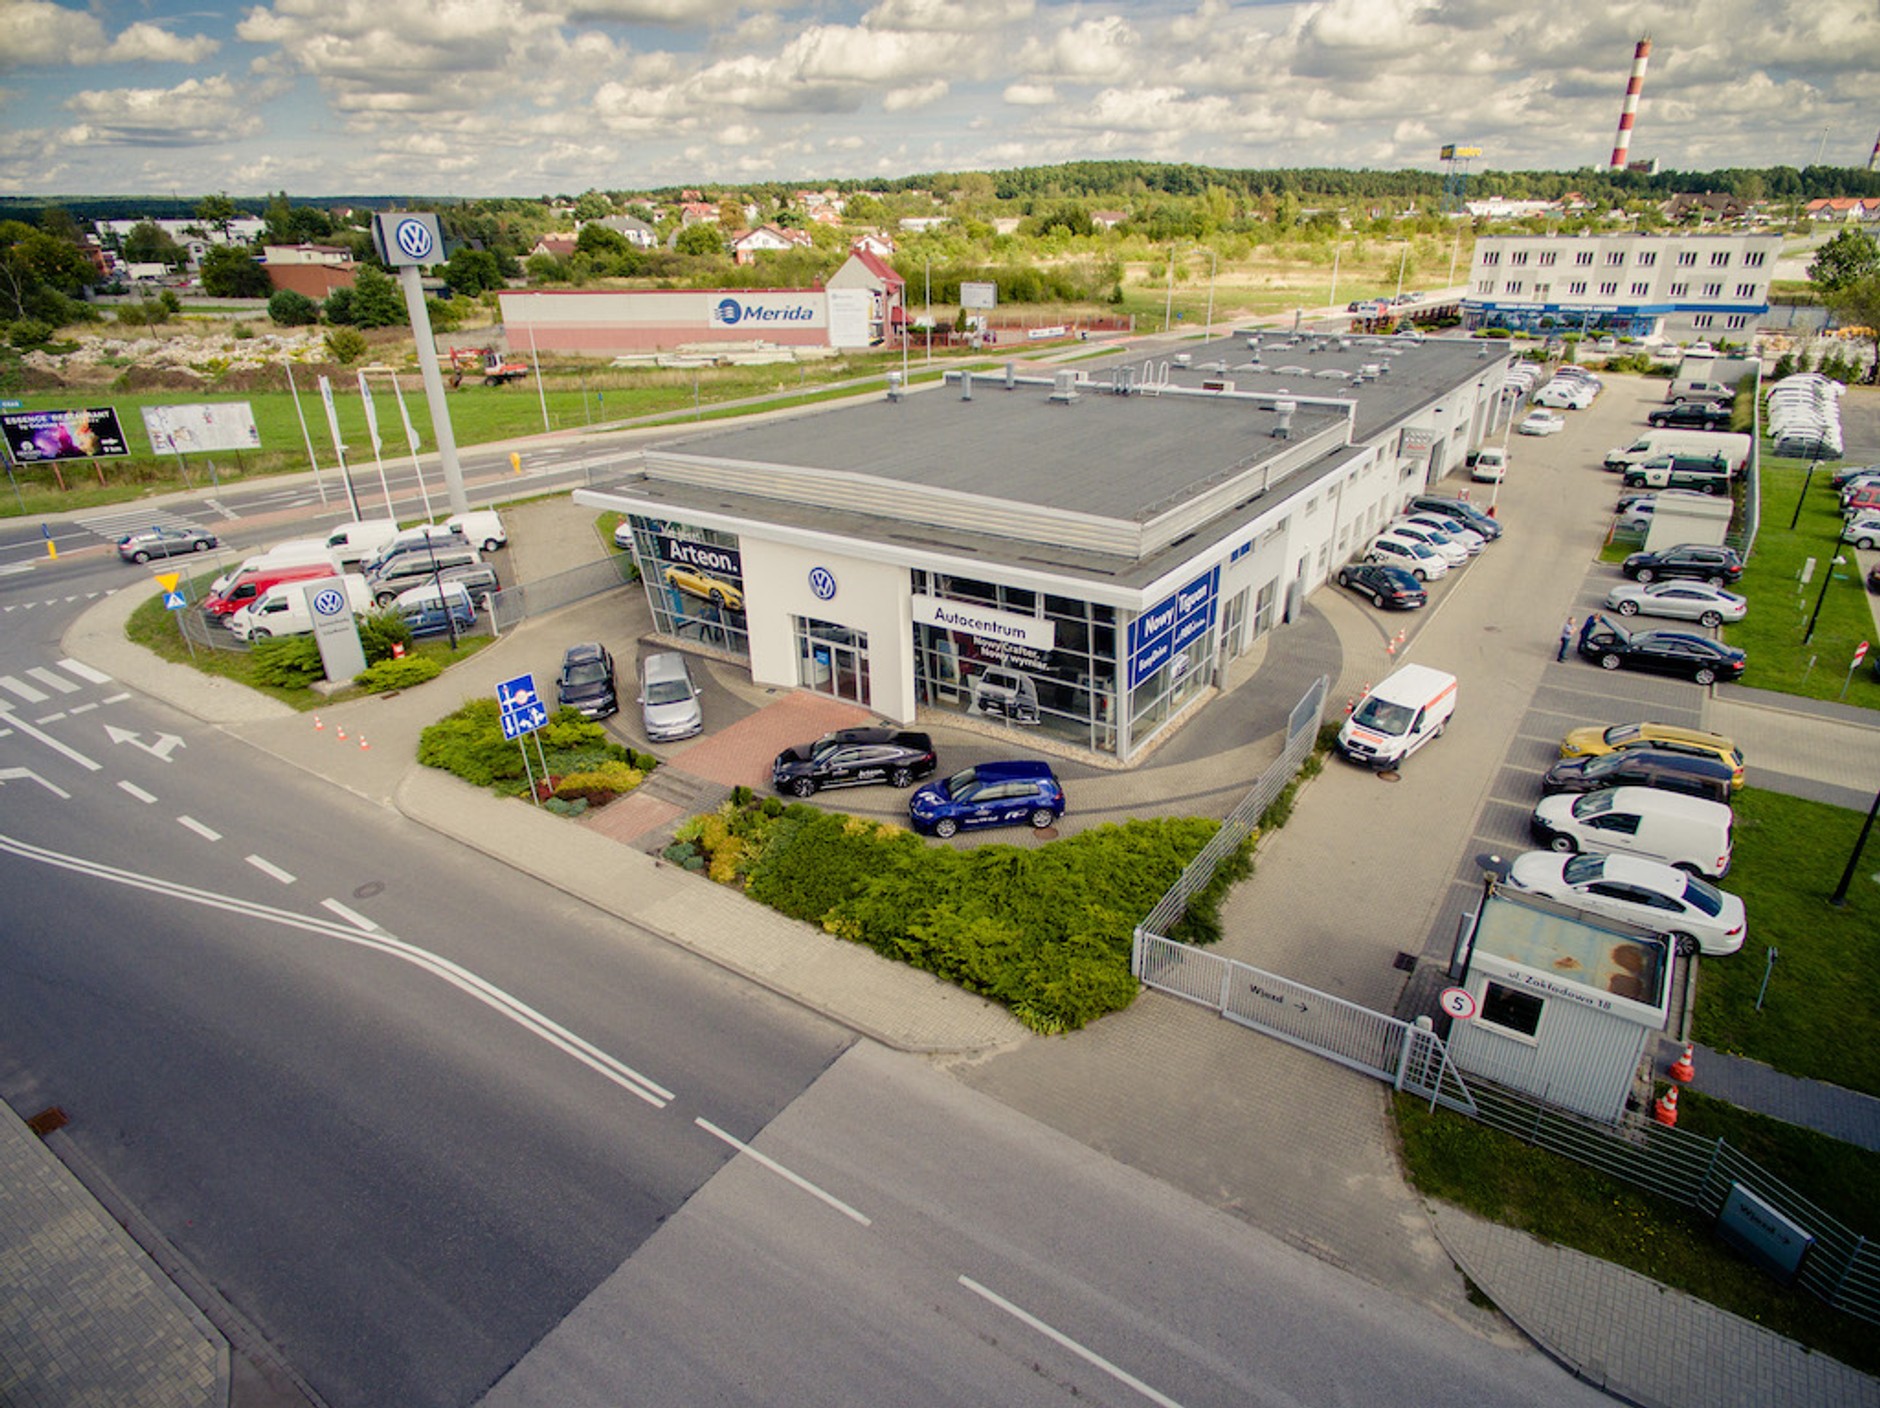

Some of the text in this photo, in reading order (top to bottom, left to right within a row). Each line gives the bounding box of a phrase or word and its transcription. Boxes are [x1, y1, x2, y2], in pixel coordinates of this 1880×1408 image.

[743, 306, 814, 321] Merida
[670, 540, 738, 572] Arteon.
[934, 607, 1026, 639] Autocentrum
[1144, 607, 1175, 638] Nowy
[1452, 996, 1465, 1011] 5
[1507, 971, 1612, 1010] ul. Zakładowa 18
